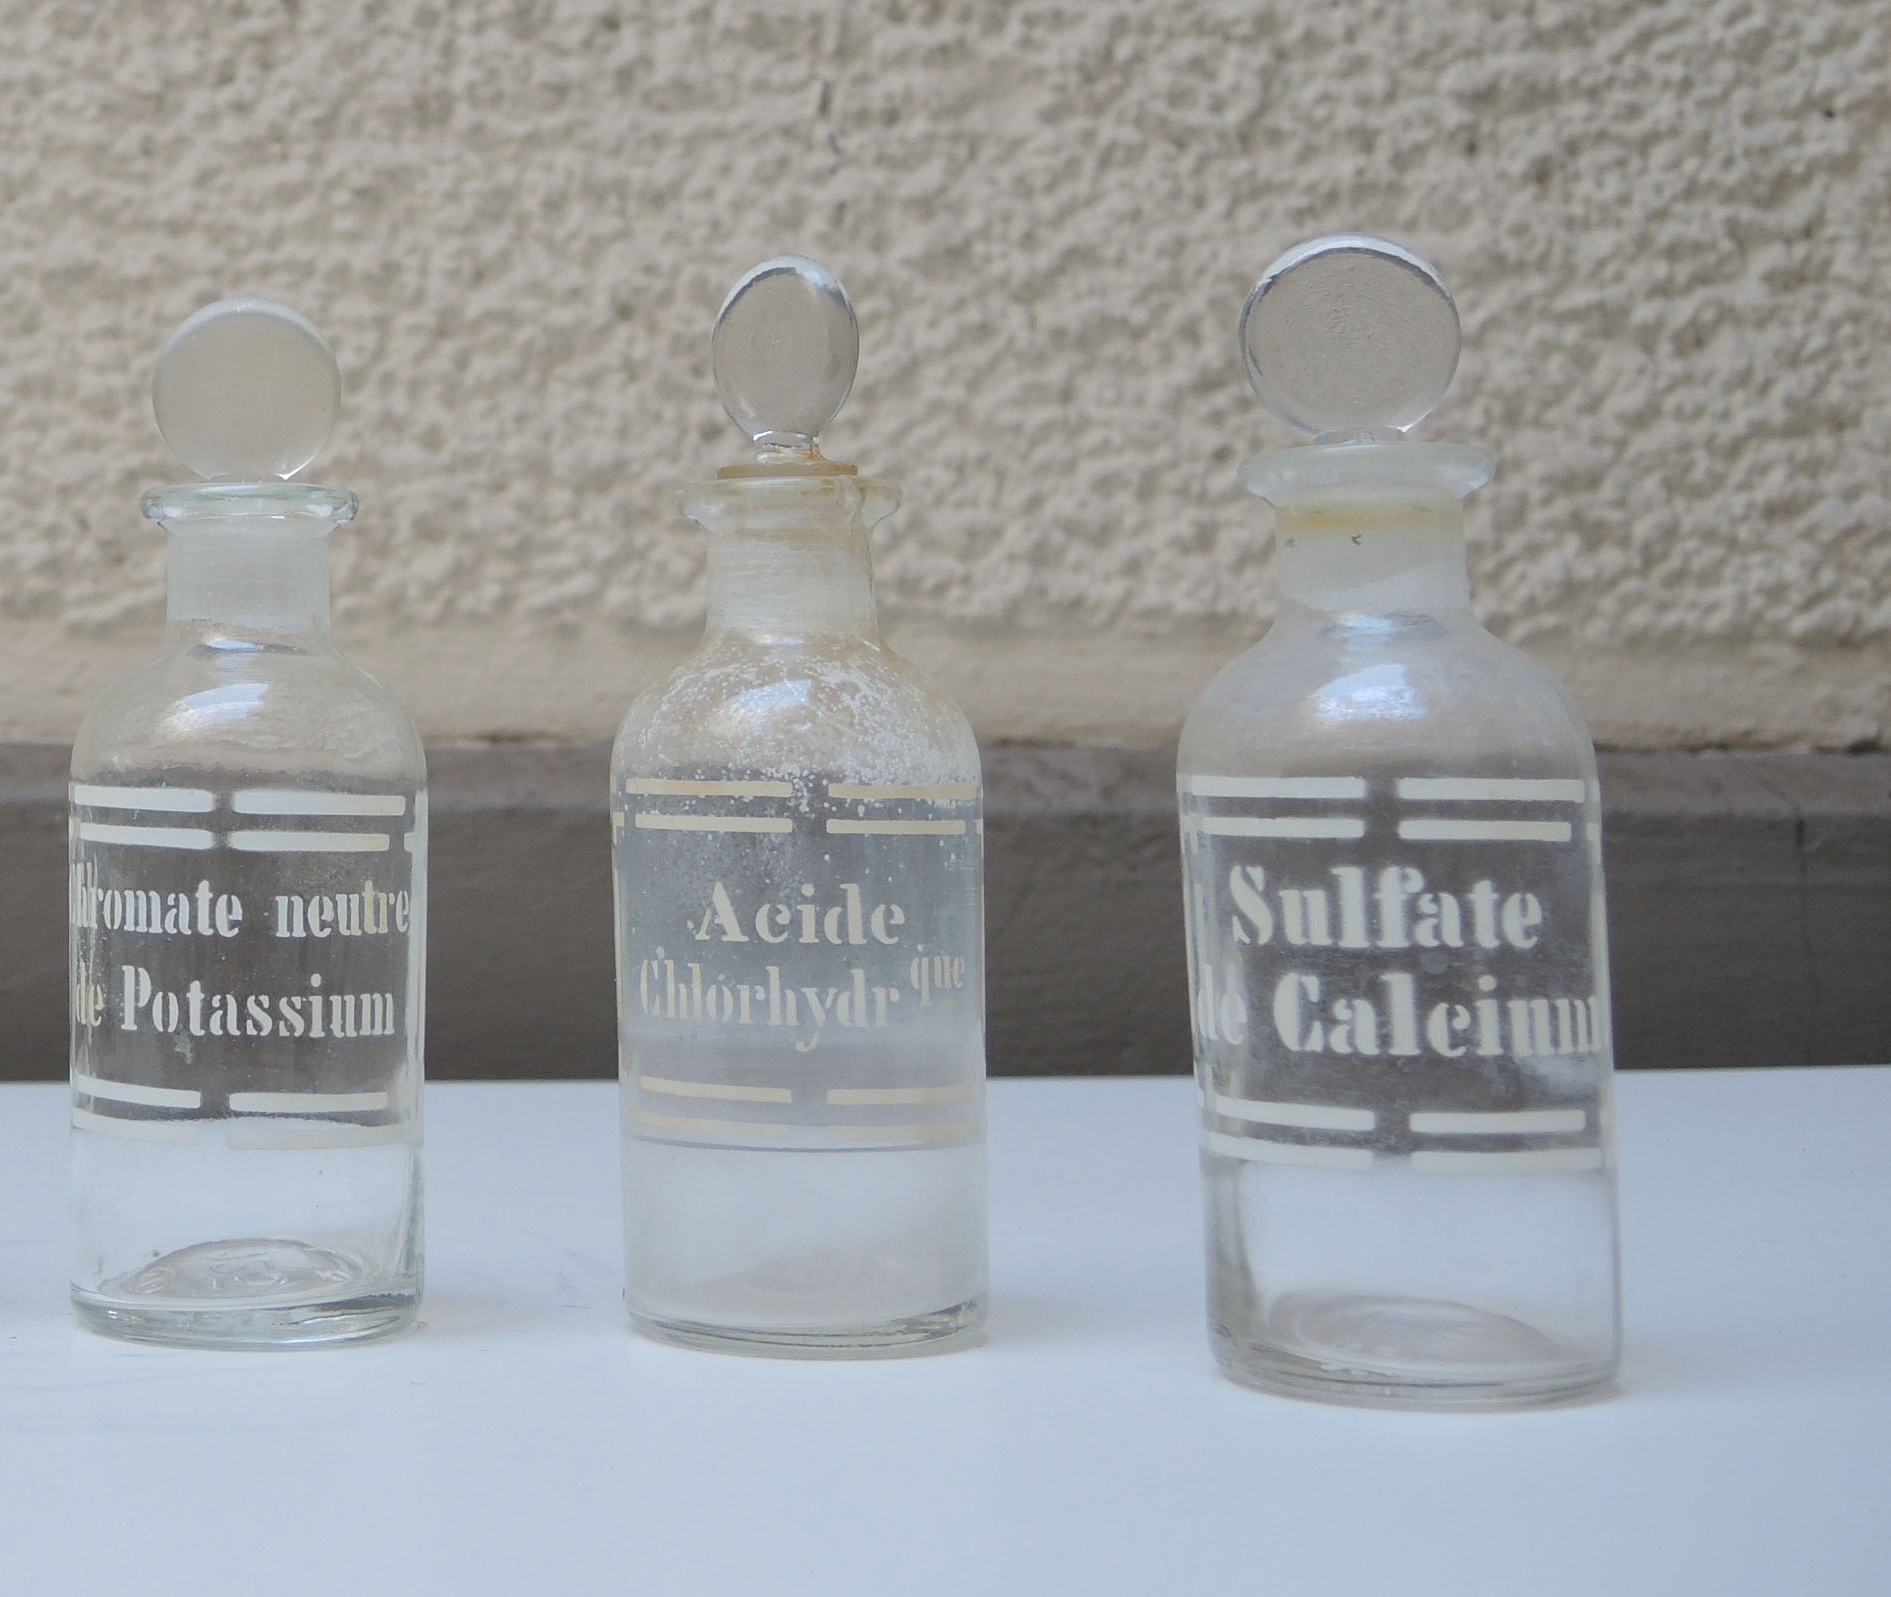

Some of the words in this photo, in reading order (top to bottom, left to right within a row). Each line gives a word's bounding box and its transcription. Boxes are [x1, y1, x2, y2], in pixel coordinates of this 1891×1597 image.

[70, 862, 243, 938] hromate
[274, 879, 410, 938] neutre
[694, 882, 906, 945] Acide
[1228, 864, 1544, 949] Sulfate
[76, 962, 105, 1028] de
[120, 964, 395, 1038] Potassium
[1197, 962, 1248, 1045] de
[1272, 971, 1603, 1058] Calcium
